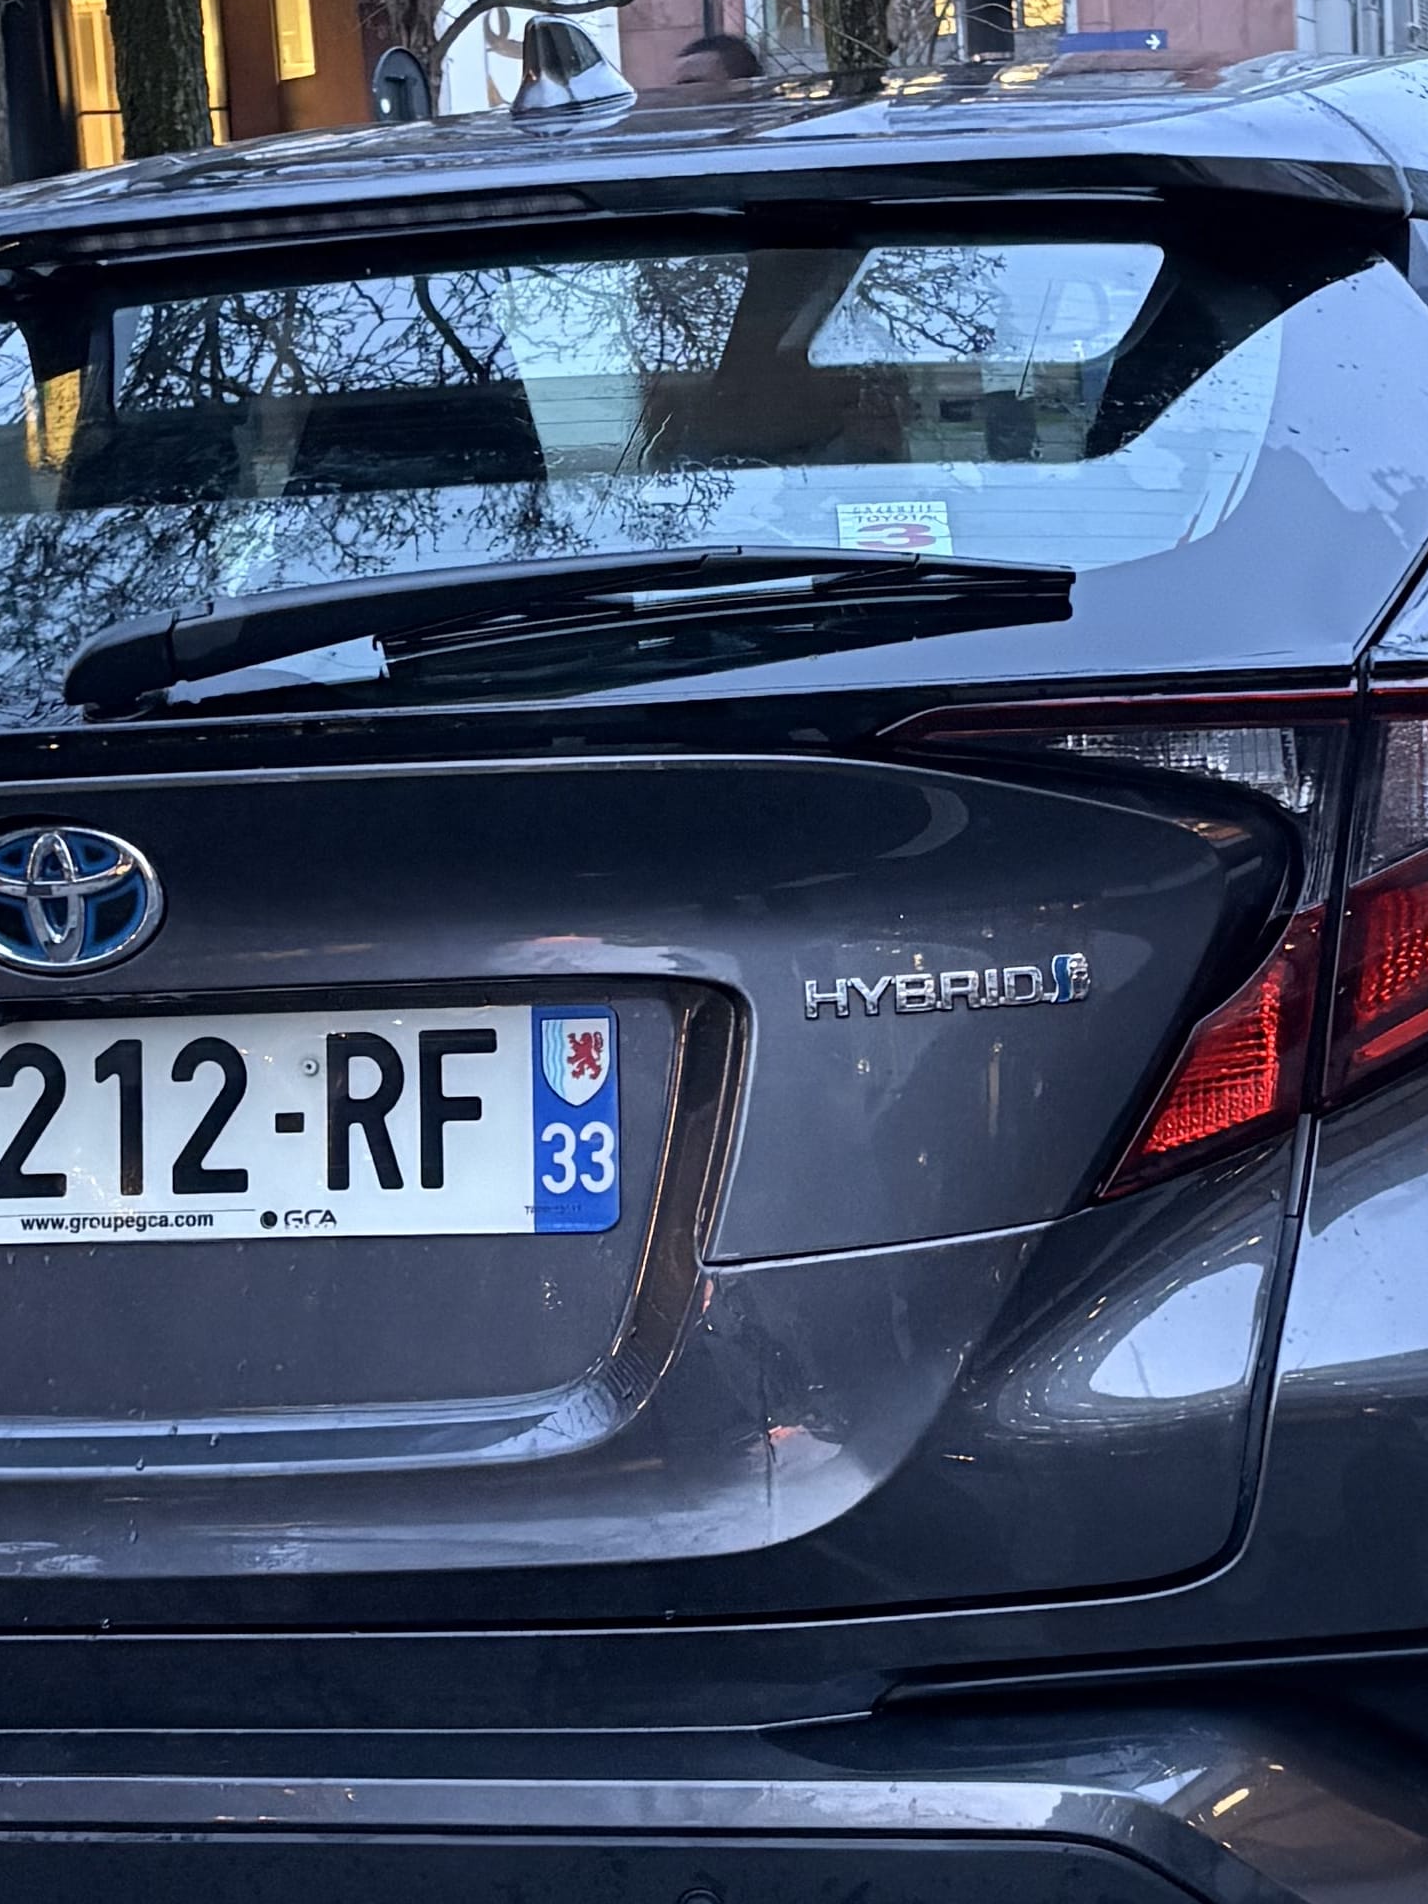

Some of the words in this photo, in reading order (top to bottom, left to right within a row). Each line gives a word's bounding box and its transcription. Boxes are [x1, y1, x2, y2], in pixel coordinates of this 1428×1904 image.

[856, 523, 937, 549] 3
[805, 966, 1042, 1018] HYBRID
[541, 1120, 615, 1194] 33
[20, 1211, 214, 1233] www.groupegca.com
[284, 1209, 337, 1226] GCA
